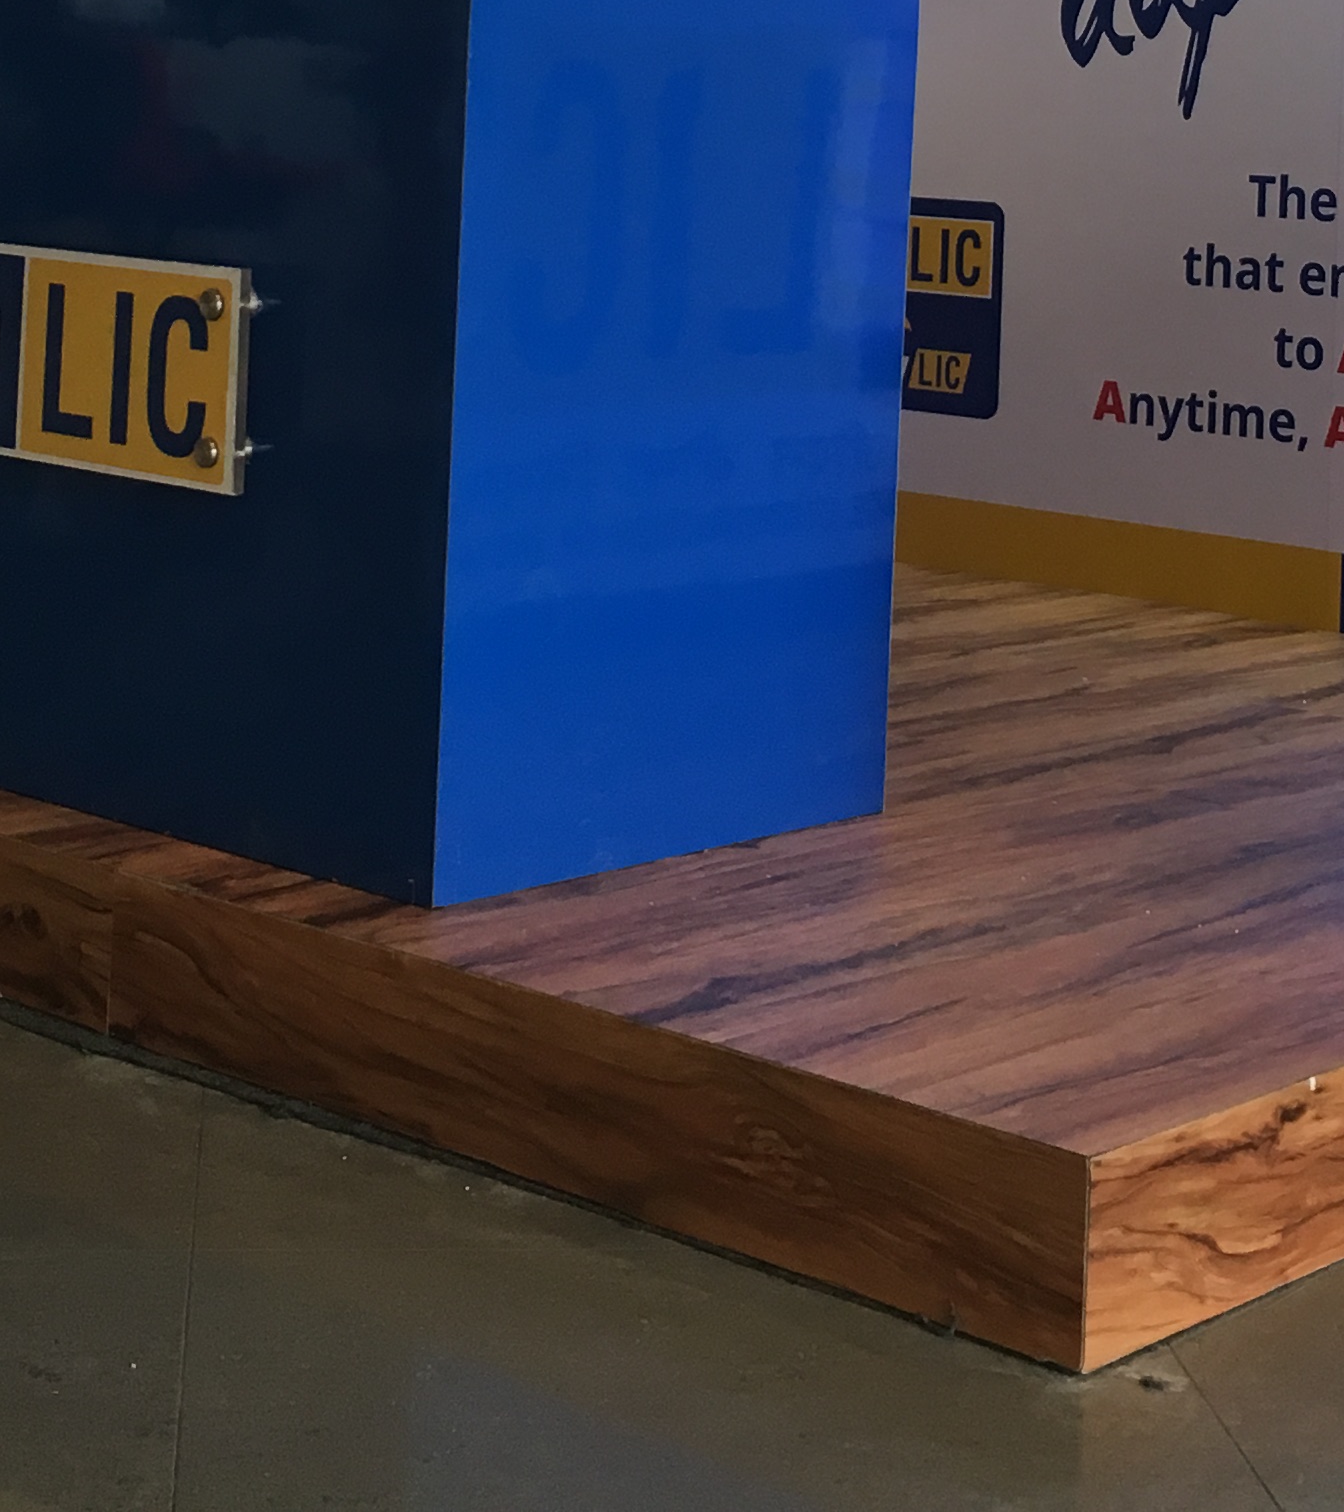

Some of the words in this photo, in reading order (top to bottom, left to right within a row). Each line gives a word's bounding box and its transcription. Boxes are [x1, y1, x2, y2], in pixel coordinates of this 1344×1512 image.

[1248, 175, 1337, 224] The
[911, 226, 981, 287] LIC
[1183, 242, 1285, 295] that
[41, 283, 210, 460] LIC
[1273, 326, 1324, 372] to
[1092, 380, 1309, 454] Anytime,
